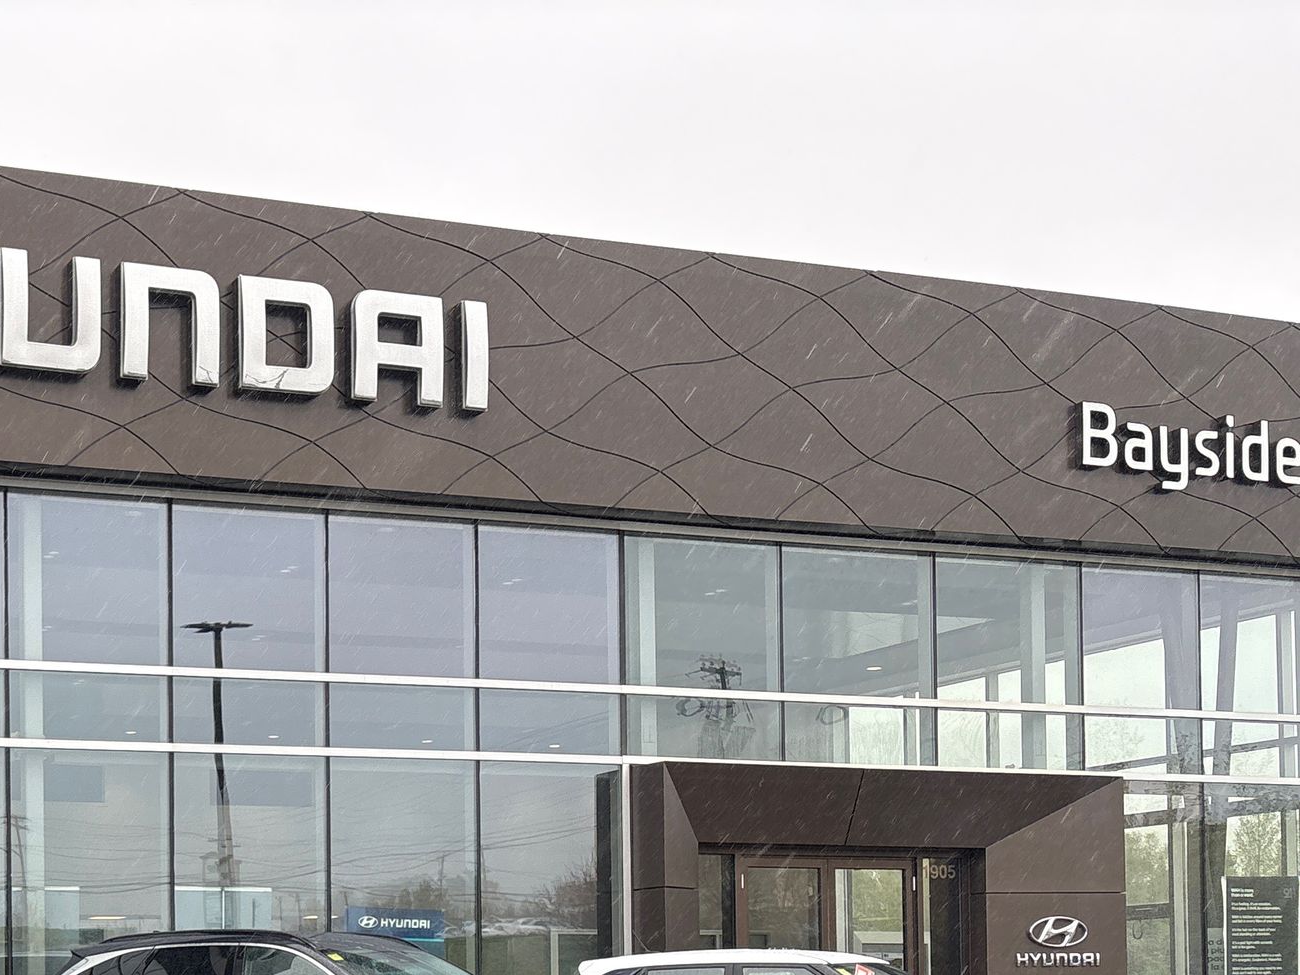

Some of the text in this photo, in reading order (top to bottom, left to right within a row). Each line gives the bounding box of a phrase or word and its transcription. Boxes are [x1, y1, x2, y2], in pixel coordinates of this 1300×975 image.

[1079, 400, 1300, 491] Bayside
[922, 864, 956, 879] 1905
[380, 918, 431, 929] HYUNDAI
[1016, 952, 1101, 967] HYUNDAI
